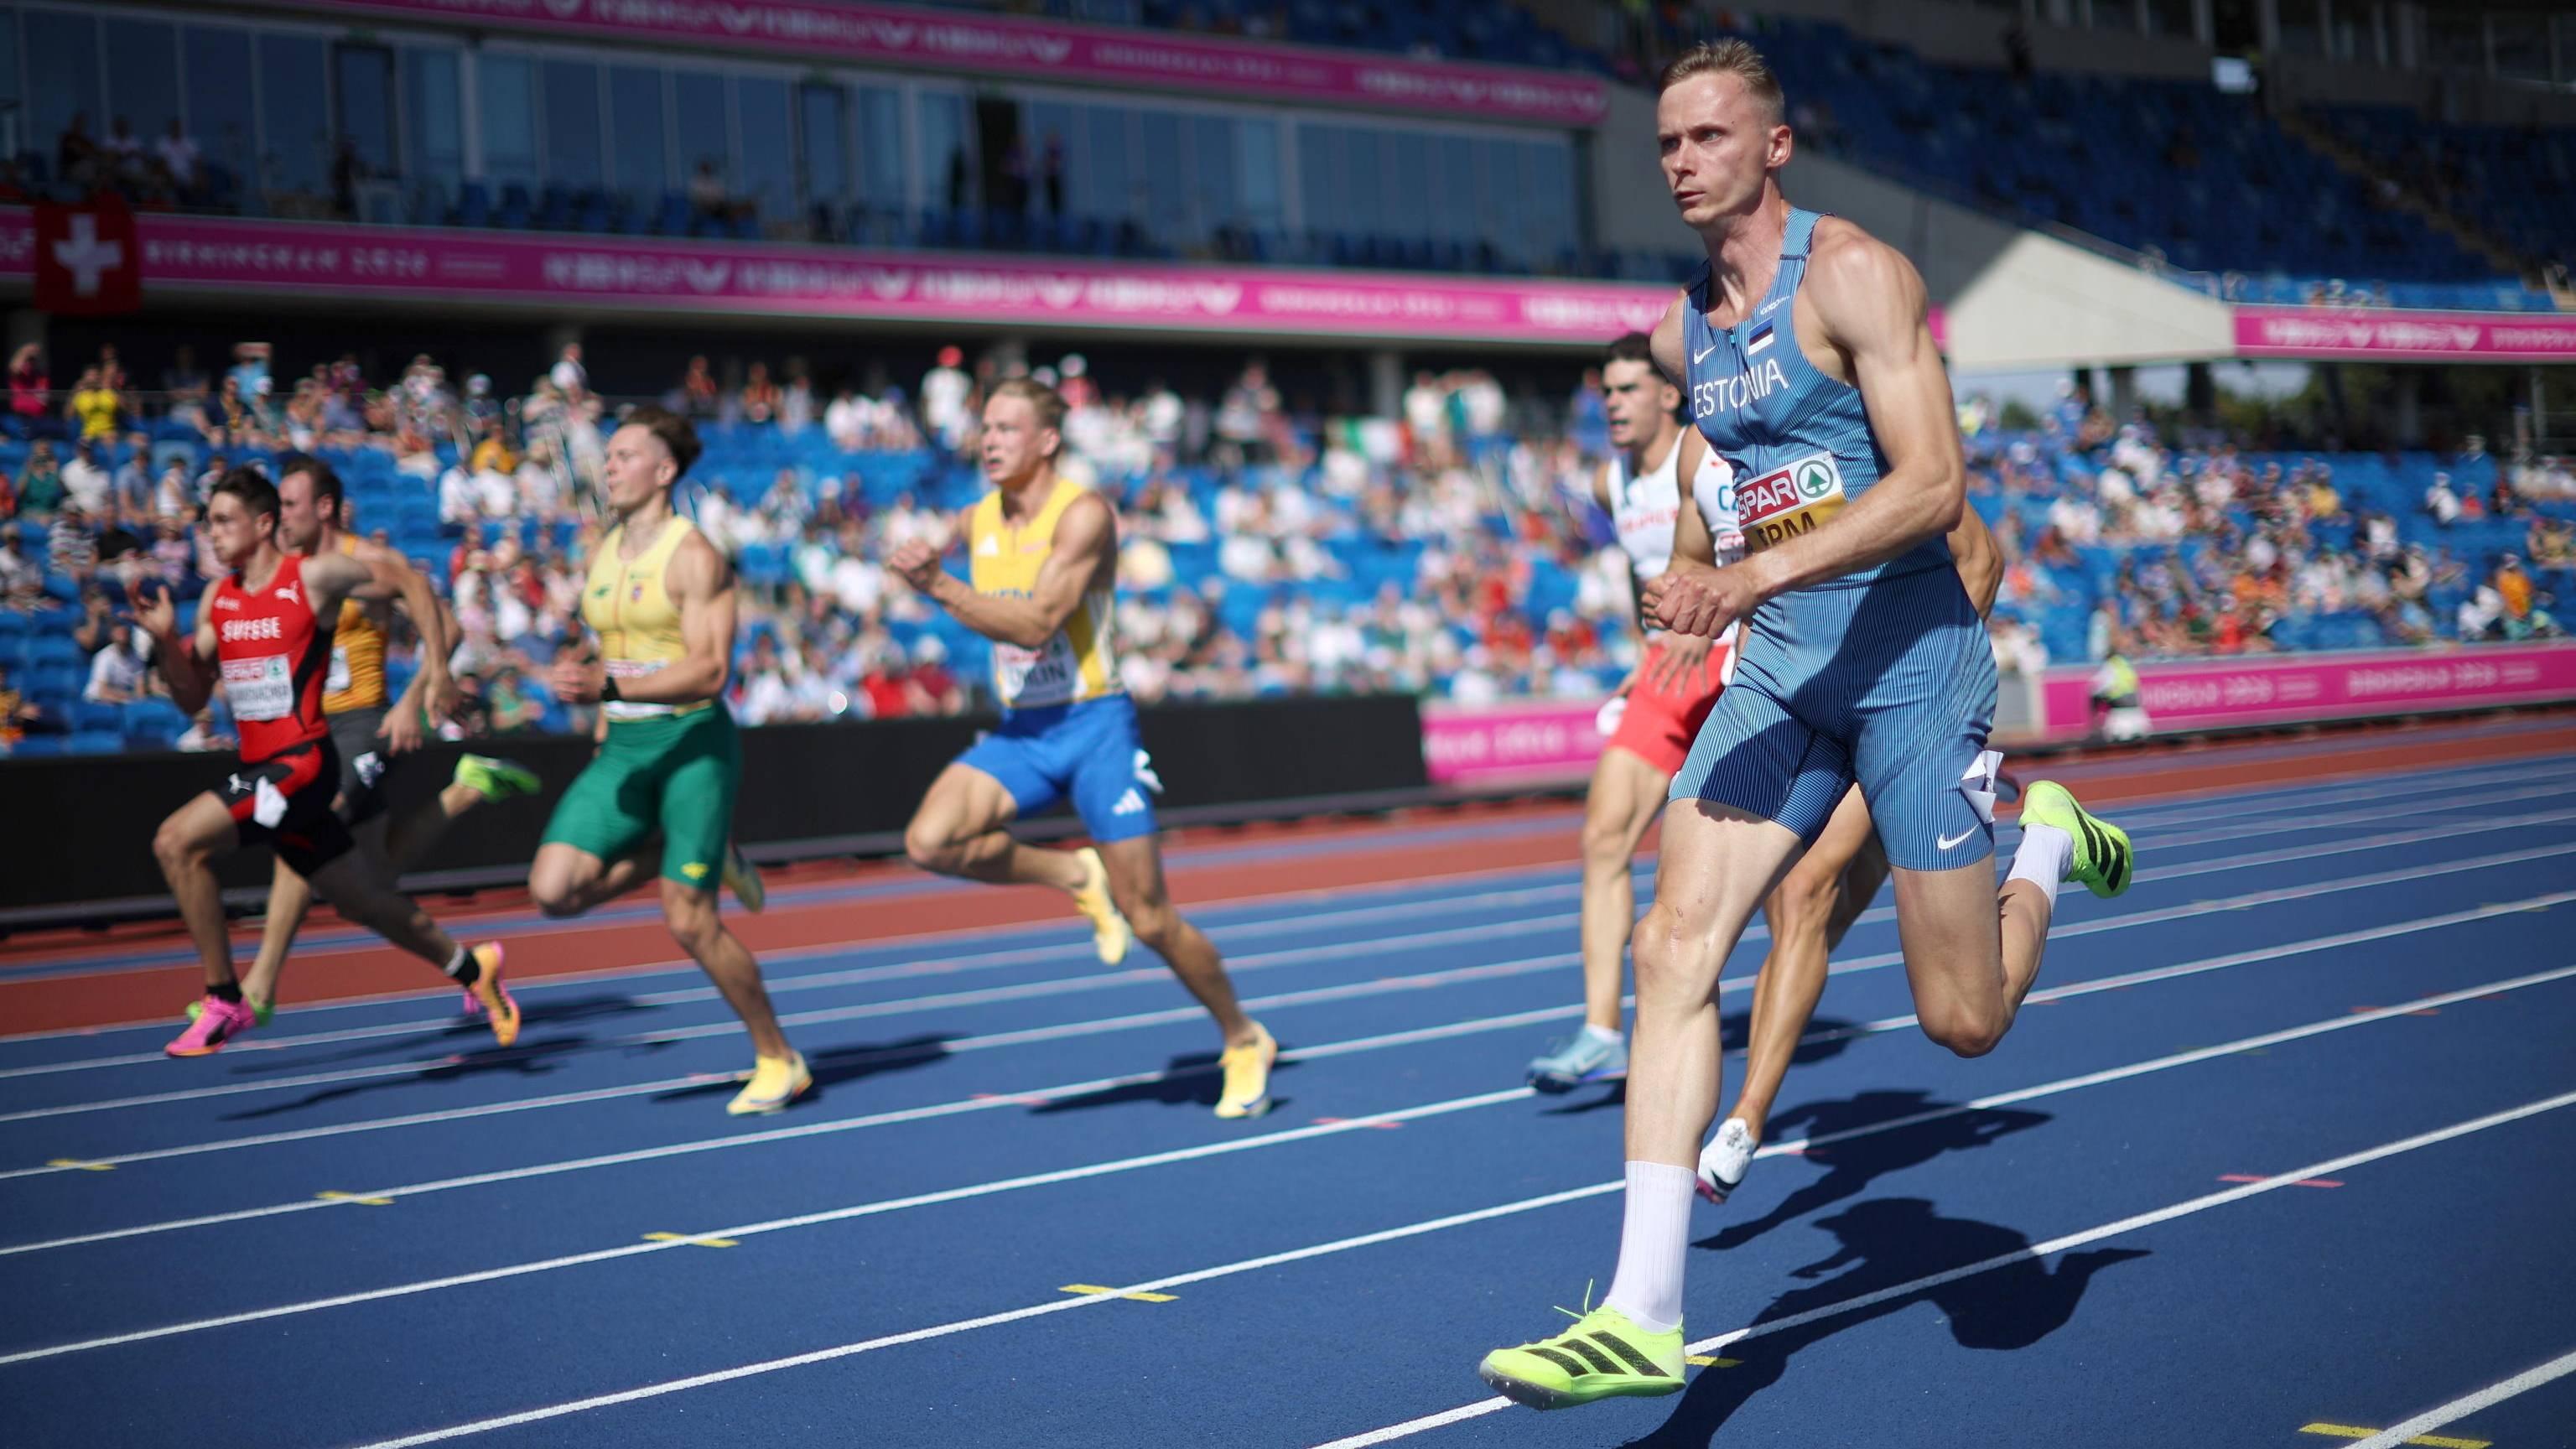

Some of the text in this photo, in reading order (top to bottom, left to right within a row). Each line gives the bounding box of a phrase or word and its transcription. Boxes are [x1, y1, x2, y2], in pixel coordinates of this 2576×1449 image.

[1694, 358, 1789, 419] ESTONIA
[1738, 476, 1796, 520] SPAR
[221, 616, 282, 642] SUISSE
